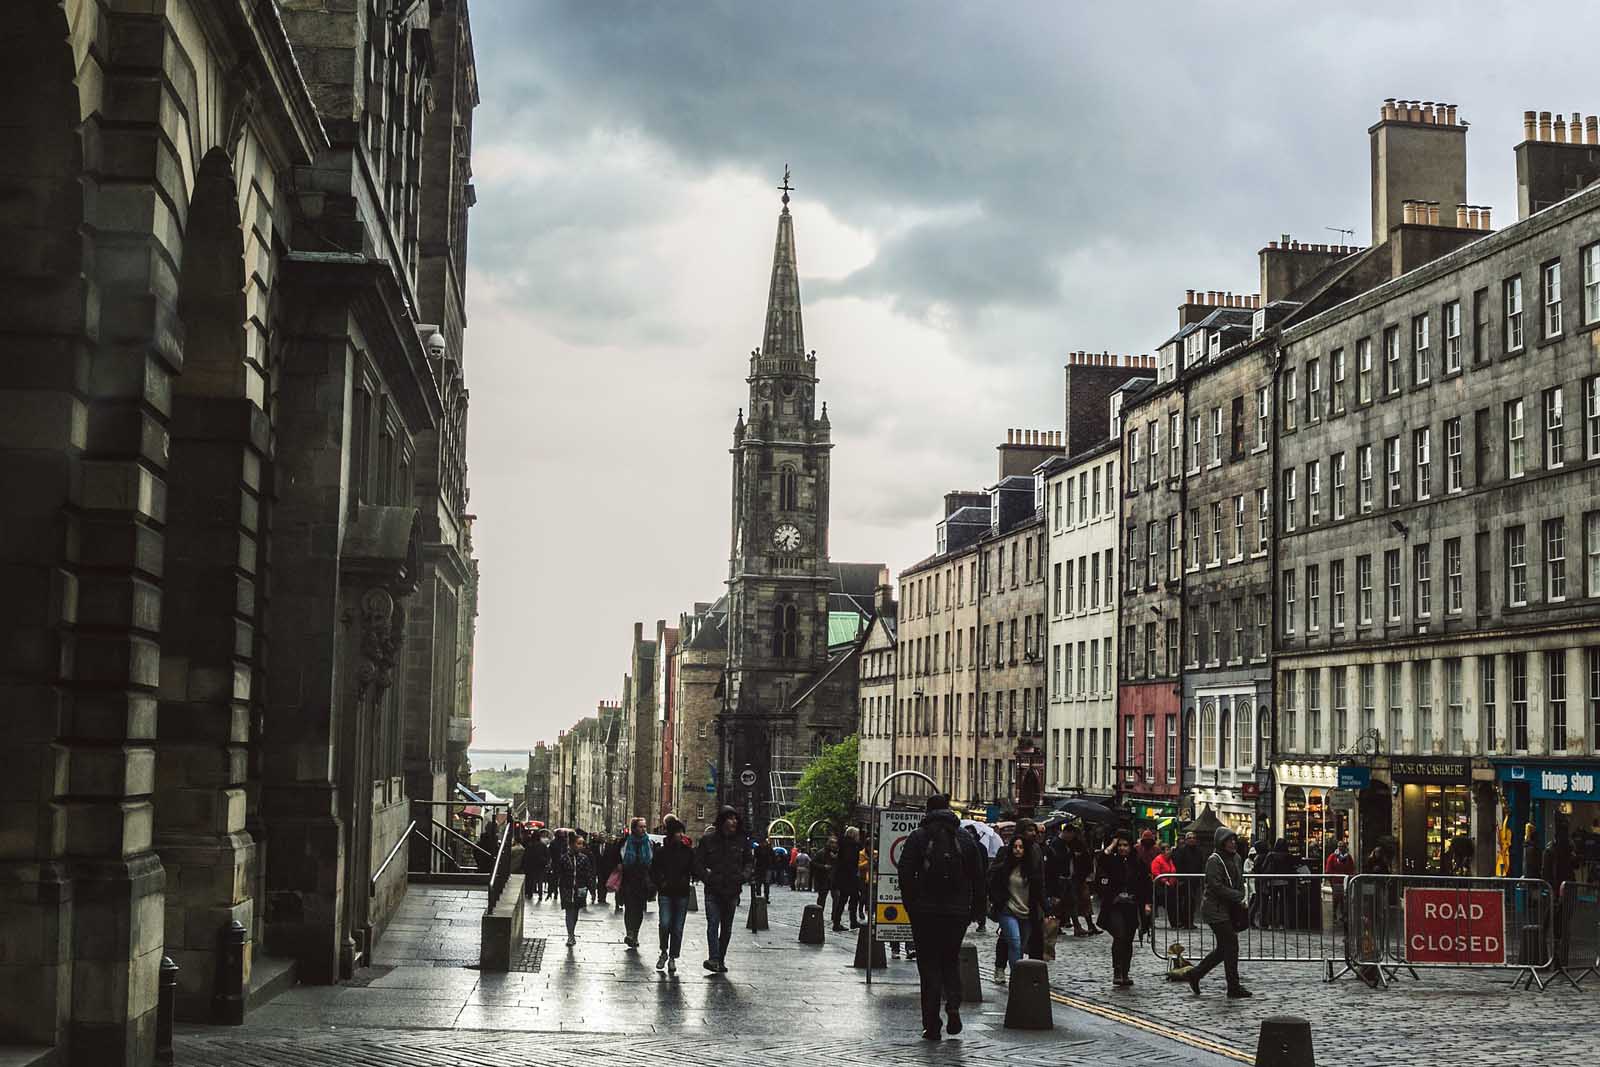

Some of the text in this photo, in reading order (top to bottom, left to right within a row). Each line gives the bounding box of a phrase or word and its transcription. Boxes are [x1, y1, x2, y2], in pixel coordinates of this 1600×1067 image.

[1416, 763, 1426, 775] OF
[1427, 763, 1465, 776] CASHMERE
[1541, 770, 1594, 794] fringe shop
[886, 813, 923, 821] PEDESTRI
[1425, 903, 1484, 920] ROAD
[1411, 934, 1499, 952] CLOSED
